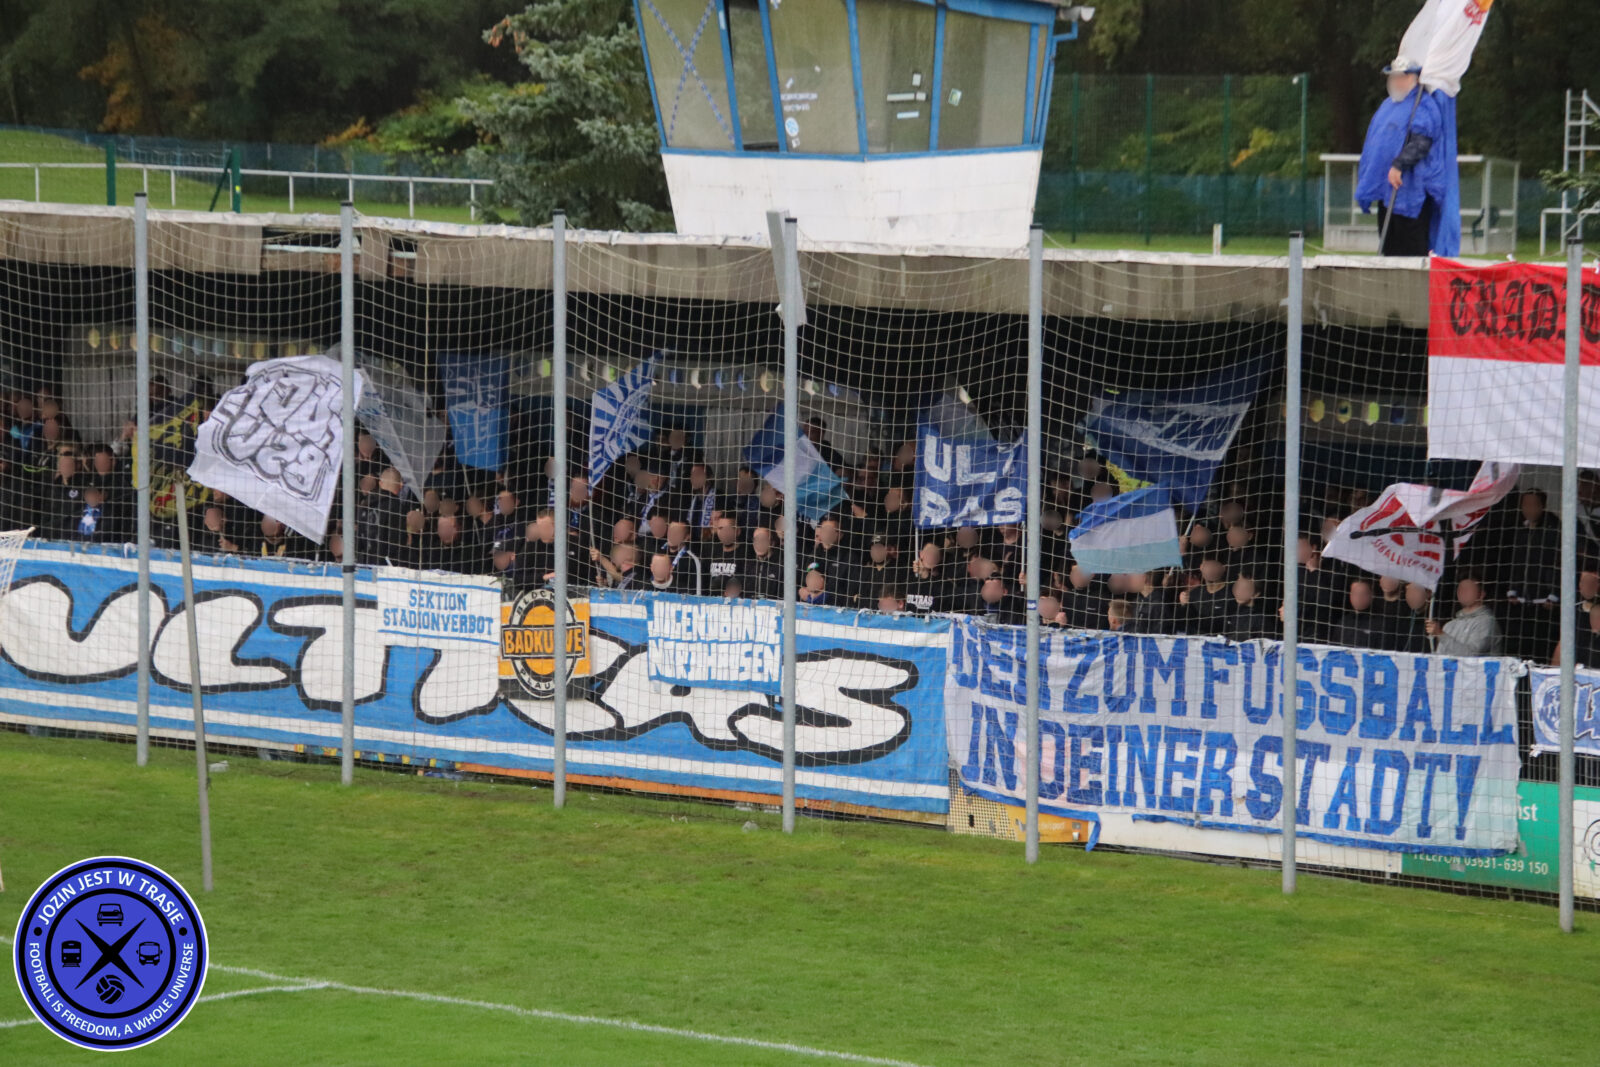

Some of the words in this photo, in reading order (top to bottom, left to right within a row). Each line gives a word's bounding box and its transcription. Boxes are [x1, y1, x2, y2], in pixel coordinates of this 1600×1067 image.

[1450, 276, 1600, 344] TRADT
[919, 487, 1022, 527] RAS
[409, 589, 467, 611] SEKTION
[907, 594, 933, 606] ULTRAS
[383, 608, 493, 636] STADIONVERBOT
[504, 628, 583, 654] BADKUVE
[648, 600, 780, 643] JUGENDBANDE
[648, 638, 780, 682] NORDHAUSEN
[1064, 635, 1188, 716] ZUM
[1201, 641, 1514, 745] FUSSBALL
[962, 701, 1018, 791] IN
[1038, 719, 1238, 817] DEINER
[1245, 735, 1481, 841] STADT!
[1528, 862, 1548, 875] 150
